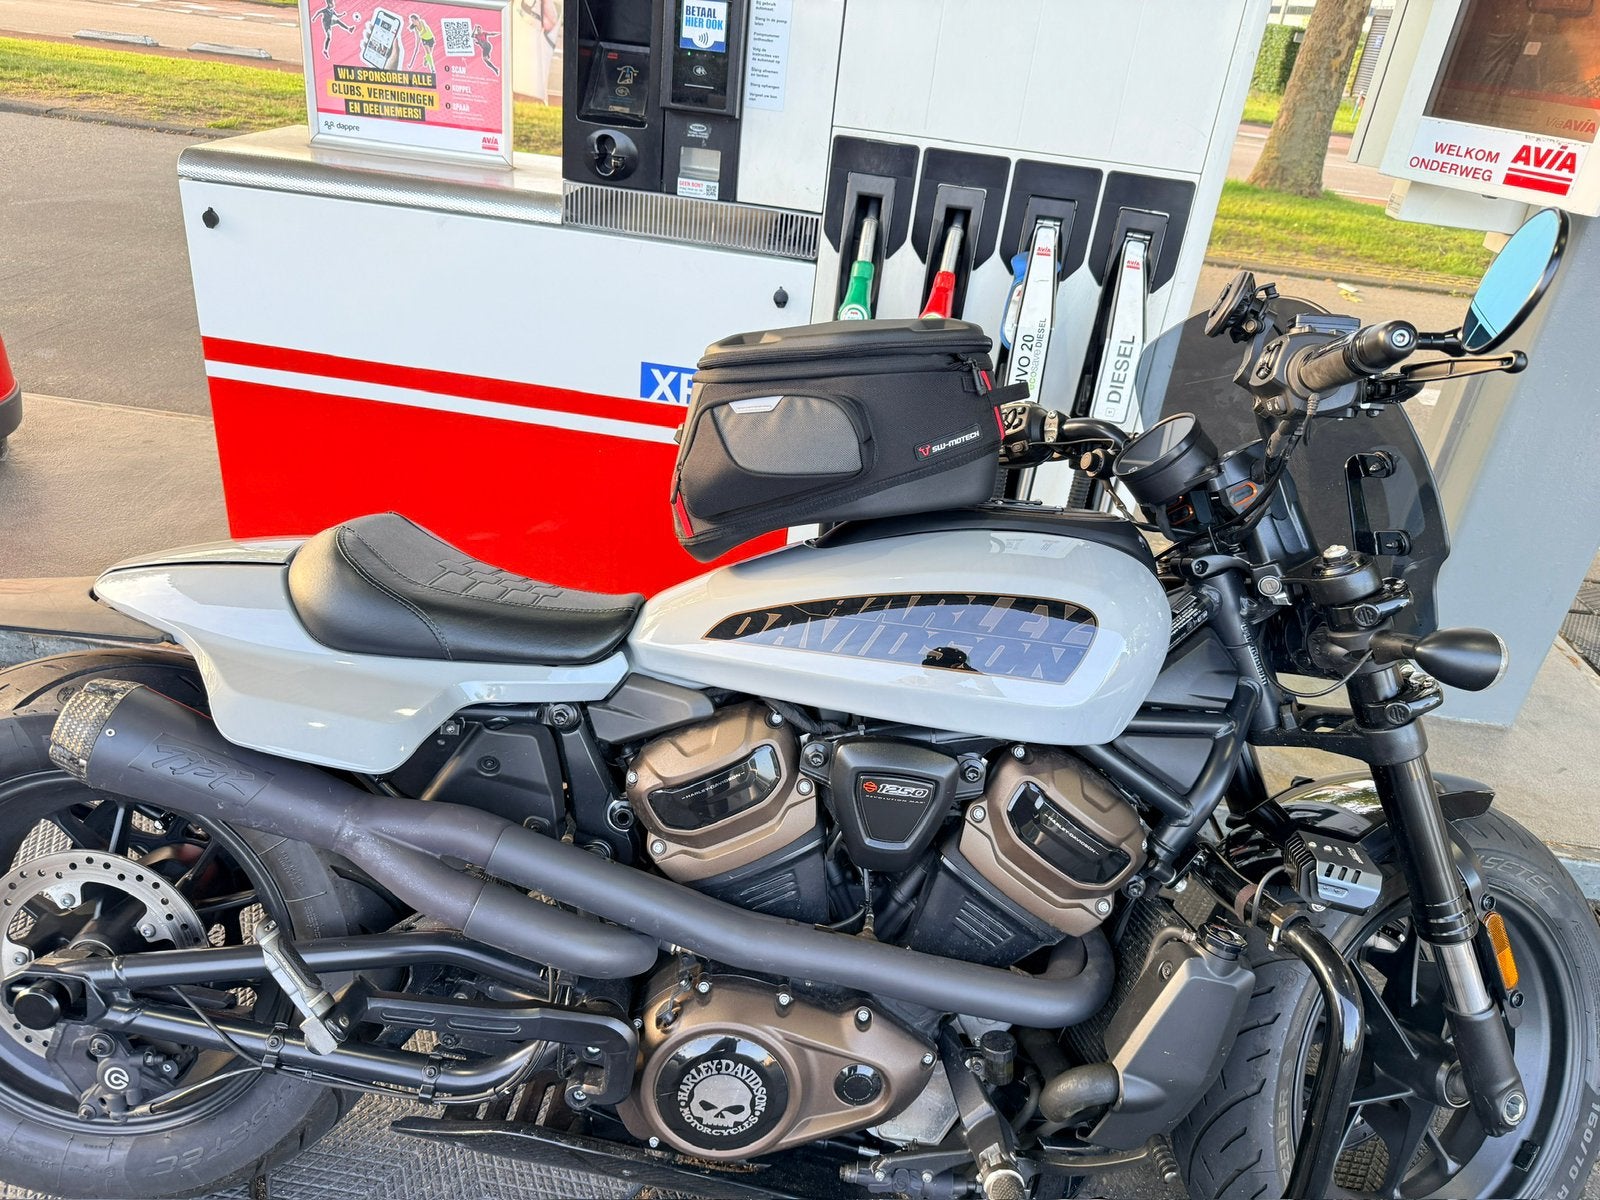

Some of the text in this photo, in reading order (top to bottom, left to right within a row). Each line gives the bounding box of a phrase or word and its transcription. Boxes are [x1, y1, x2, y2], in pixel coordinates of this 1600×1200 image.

[685, 5, 717, 19] BETAAL
[685, 16, 723, 30] HIER OOK
[337, 67, 432, 87] WIJ SPONSOREN ALLE
[331, 82, 365, 98] CLUBS,
[367, 87, 435, 107] VERENIGINGEN
[348, 101, 422, 120] EN DEELNEMERS!
[336, 122, 360, 132] dappre
[481, 136, 499, 145] AVIA
[1434, 141, 1500, 164] WELKOM
[1511, 144, 1577, 174] AVIA
[1409, 156, 1493, 182] ONDERWEG
[1021, 334, 1035, 352] 20
[1034, 317, 1047, 348] DIESEL
[1106, 335, 1136, 404] DIESEL
[931, 430, 980, 453] SW-MOTECH
[877, 783, 929, 798] 1250
[677, 1059, 767, 1113] HARLEY-DAVIDSON
[680, 1107, 759, 1136] MOTORCYCLES
